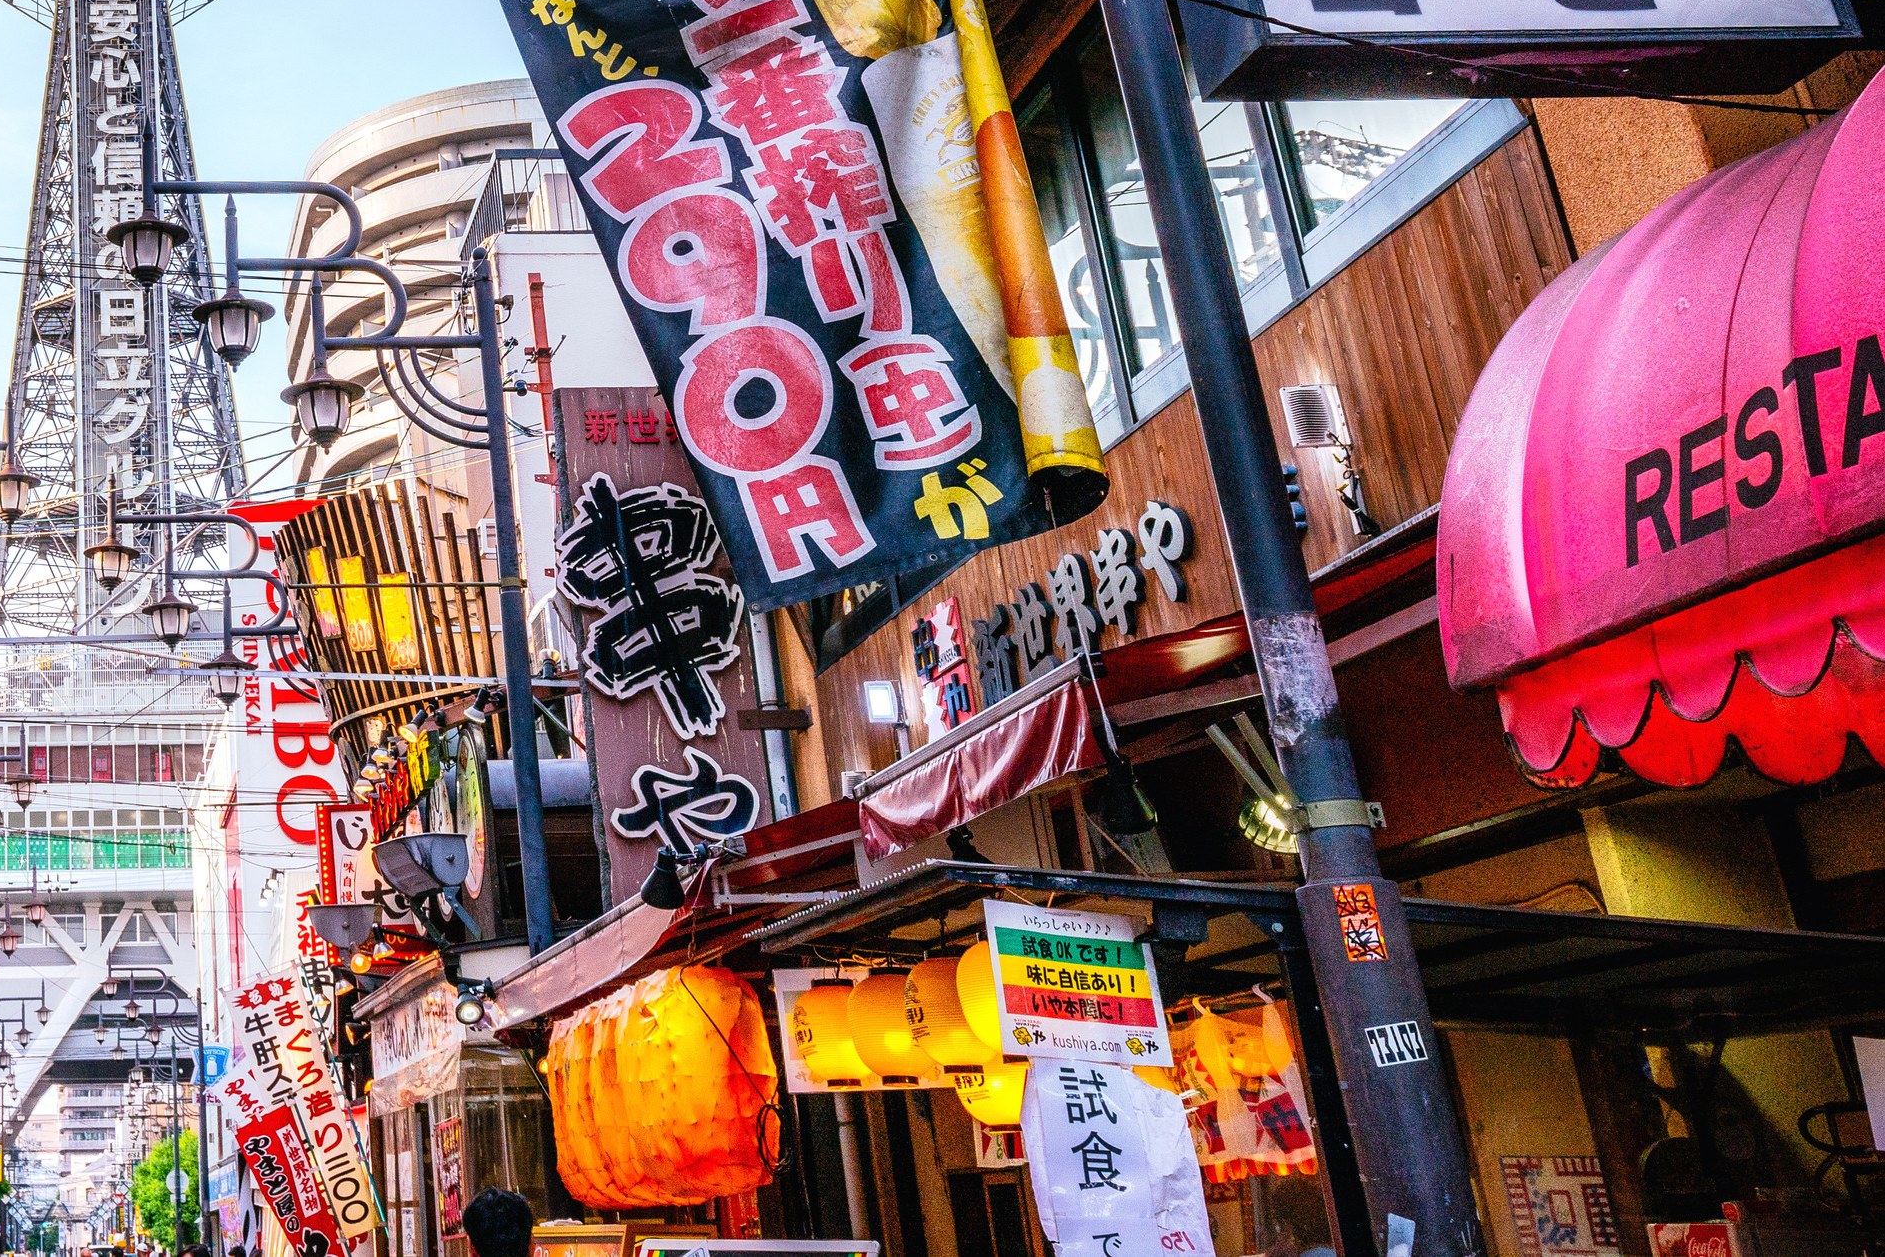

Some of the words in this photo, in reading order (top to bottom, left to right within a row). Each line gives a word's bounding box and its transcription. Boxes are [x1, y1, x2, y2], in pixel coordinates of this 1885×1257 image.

[560, 79, 877, 583] 290円
[584, 409, 678, 444] 新世
[1051, 1033, 1123, 1054] kushiya.com
